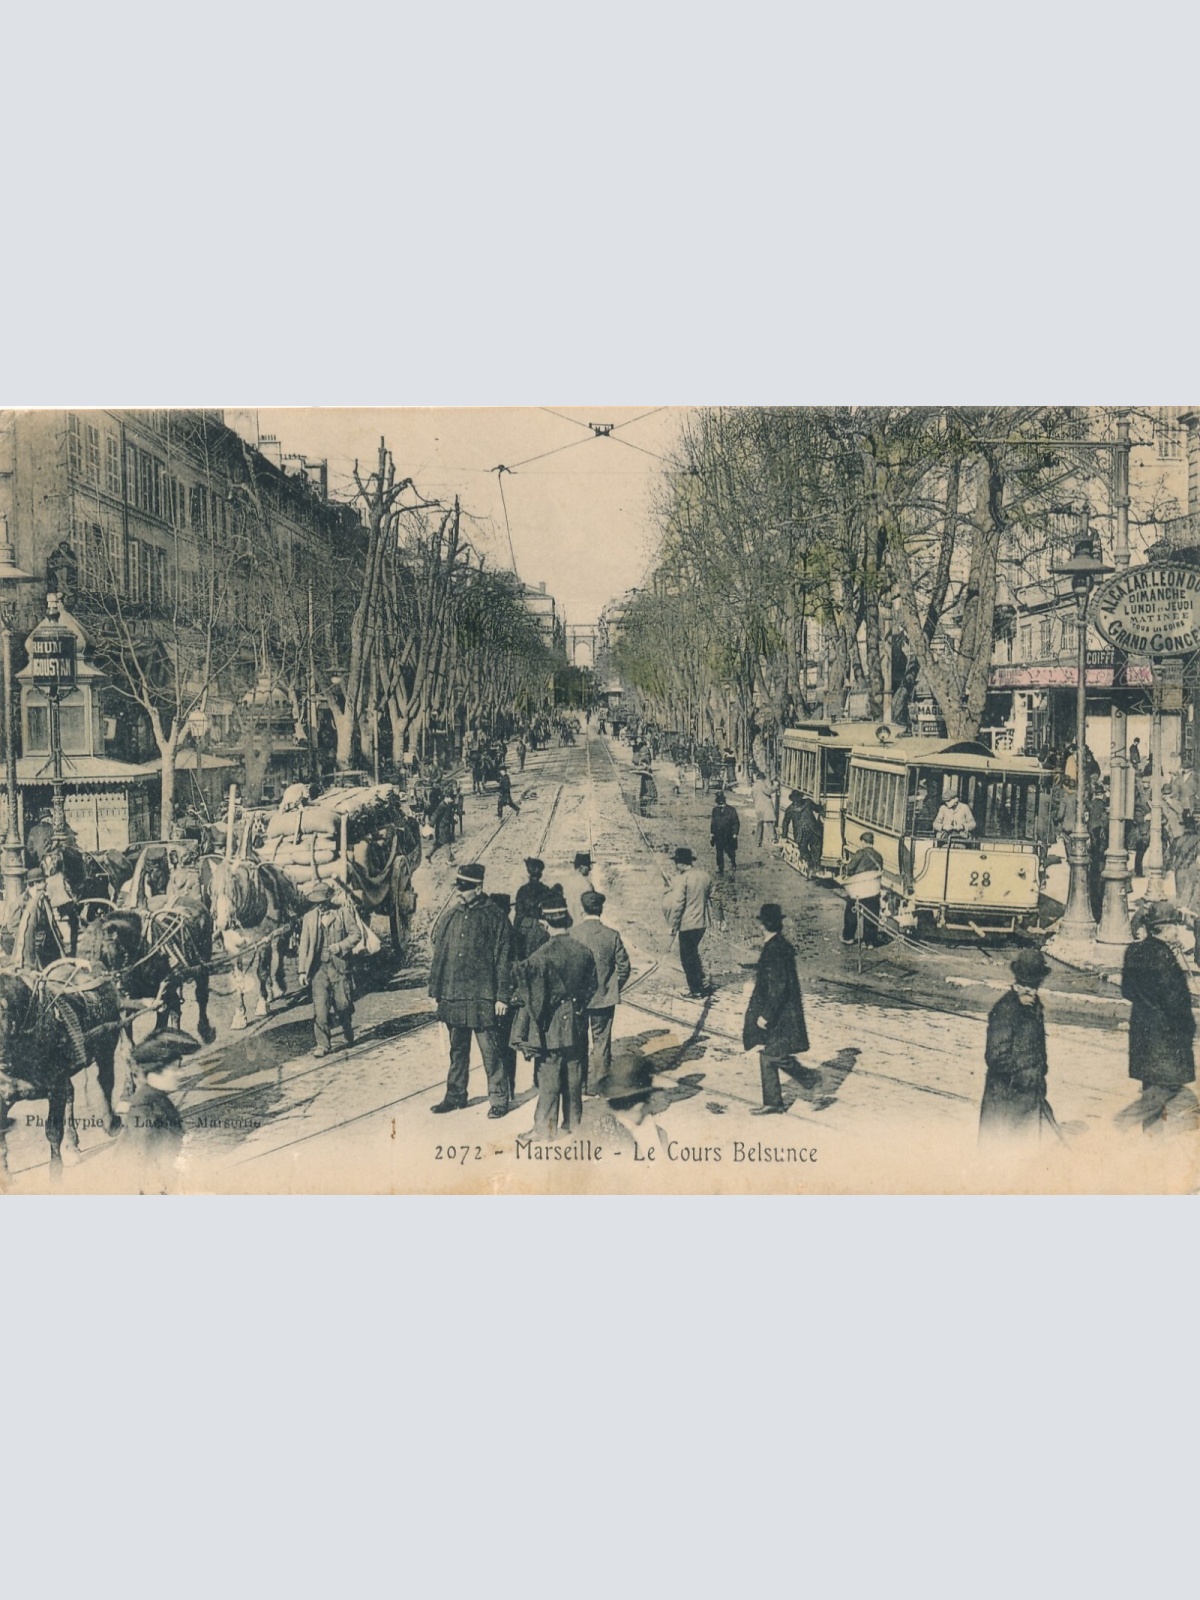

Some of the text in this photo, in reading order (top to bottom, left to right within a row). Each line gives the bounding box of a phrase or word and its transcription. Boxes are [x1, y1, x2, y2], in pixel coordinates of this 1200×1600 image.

[1129, 588, 1186, 603] DIMANCHE
[1124, 603, 1155, 615] LUNDI
[1164, 601, 1193, 611] JEUDI
[1132, 623, 1150, 632] TOUS
[1163, 620, 1185, 632] SOIRS
[1108, 620, 1147, 650] GRAND
[969, 871, 991, 887] 28
